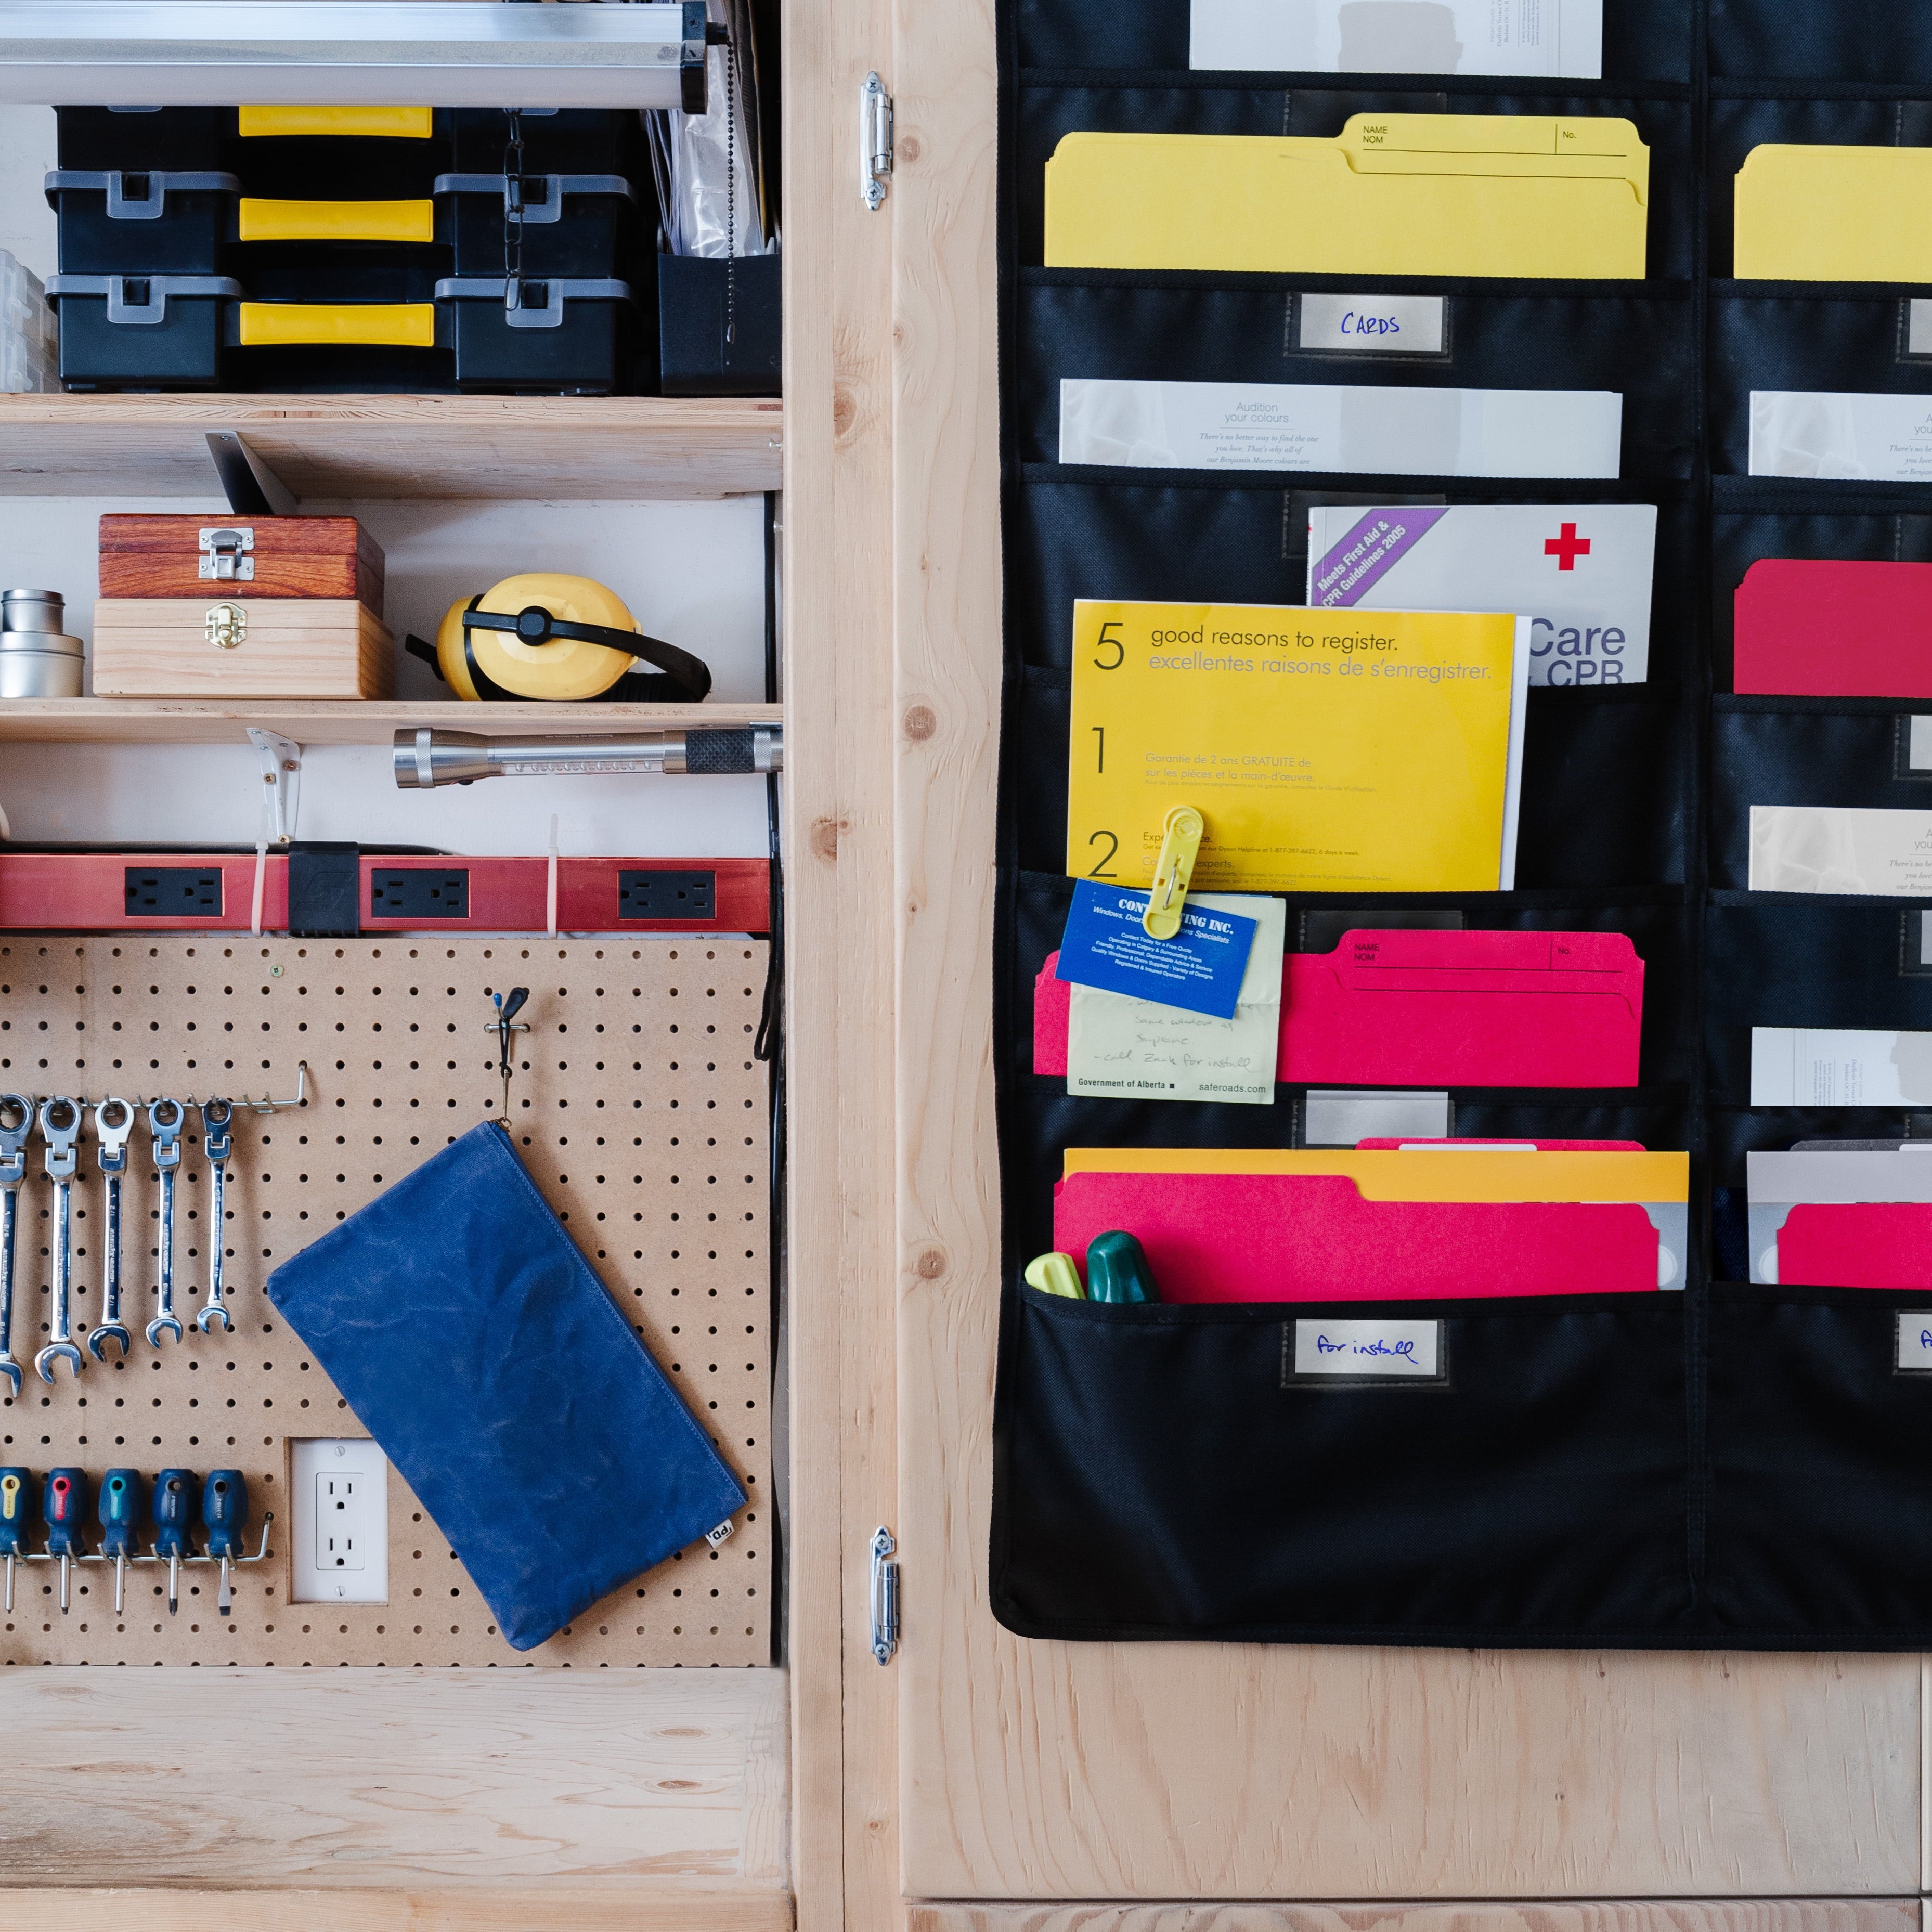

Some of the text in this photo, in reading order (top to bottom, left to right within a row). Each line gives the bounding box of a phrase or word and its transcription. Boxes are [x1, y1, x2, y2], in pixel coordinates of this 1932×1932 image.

[1563, 130, 1576, 139] No.
[1341, 311, 1400, 334] CARDS
[1236, 402, 1278, 412] Audition
[1225, 413, 1289, 423] your colours
[1295, 446, 1303, 455] of
[1317, 521, 1390, 591] Meets First Aid &
[1340, 547, 1385, 591] Guidelines
[1382, 524, 1406, 550] 2005
[1094, 623, 1397, 670] 5 good reasons to register.
[1530, 618, 1625, 657] Care
[1149, 651, 1254, 672] excellentes
[1262, 655, 1331, 675] raisons
[1339, 656, 1363, 676] de
[1547, 660, 1623, 686] CPR
[1091, 727, 1105, 773] 1
[1145, 752, 1190, 763] Garantie
[1194, 754, 1207, 764] de
[1210, 755, 1217, 764] 2
[1242, 756, 1295, 767] GRATUITE
[1298, 758, 1311, 767] de
[1164, 768, 1177, 777] les
[1181, 769, 1212, 779] pièces
[1228, 770, 1237, 779] la
[1088, 831, 1119, 878] 2
[1196, 860, 1235, 870] experts.
[1121, 932, 1139, 941] Contact
[1208, 919, 1235, 935] INC.
[1195, 930, 1230, 944] Specialists
[1108, 937, 1131, 946] Operating
[1136, 943, 1155, 952] Calgary
[1160, 949, 1188, 960] Surrounding
[1146, 953, 1174, 963] Dependable
[1354, 943, 1571, 956] NAME No.
[1354, 953, 1375, 961] NOM
[1091, 946, 1108, 955] Quality
[1108, 951, 1129, 959] Windows
[1149, 961, 1169, 969] Supplied
[1195, 971, 1213, 980] Designs
[1114, 959, 1140, 970] Registered
[1162, 971, 1186, 980] Operators
[1184, 1054, 1203, 1067] for
[1208, 1057, 1256, 1073] install
[1079, 1078, 1124, 1087] Government
[1137, 1080, 1165, 1089] Alberta
[1199, 1083, 1266, 1093] saferoads.com
[1317, 1335, 1419, 1365] for install
